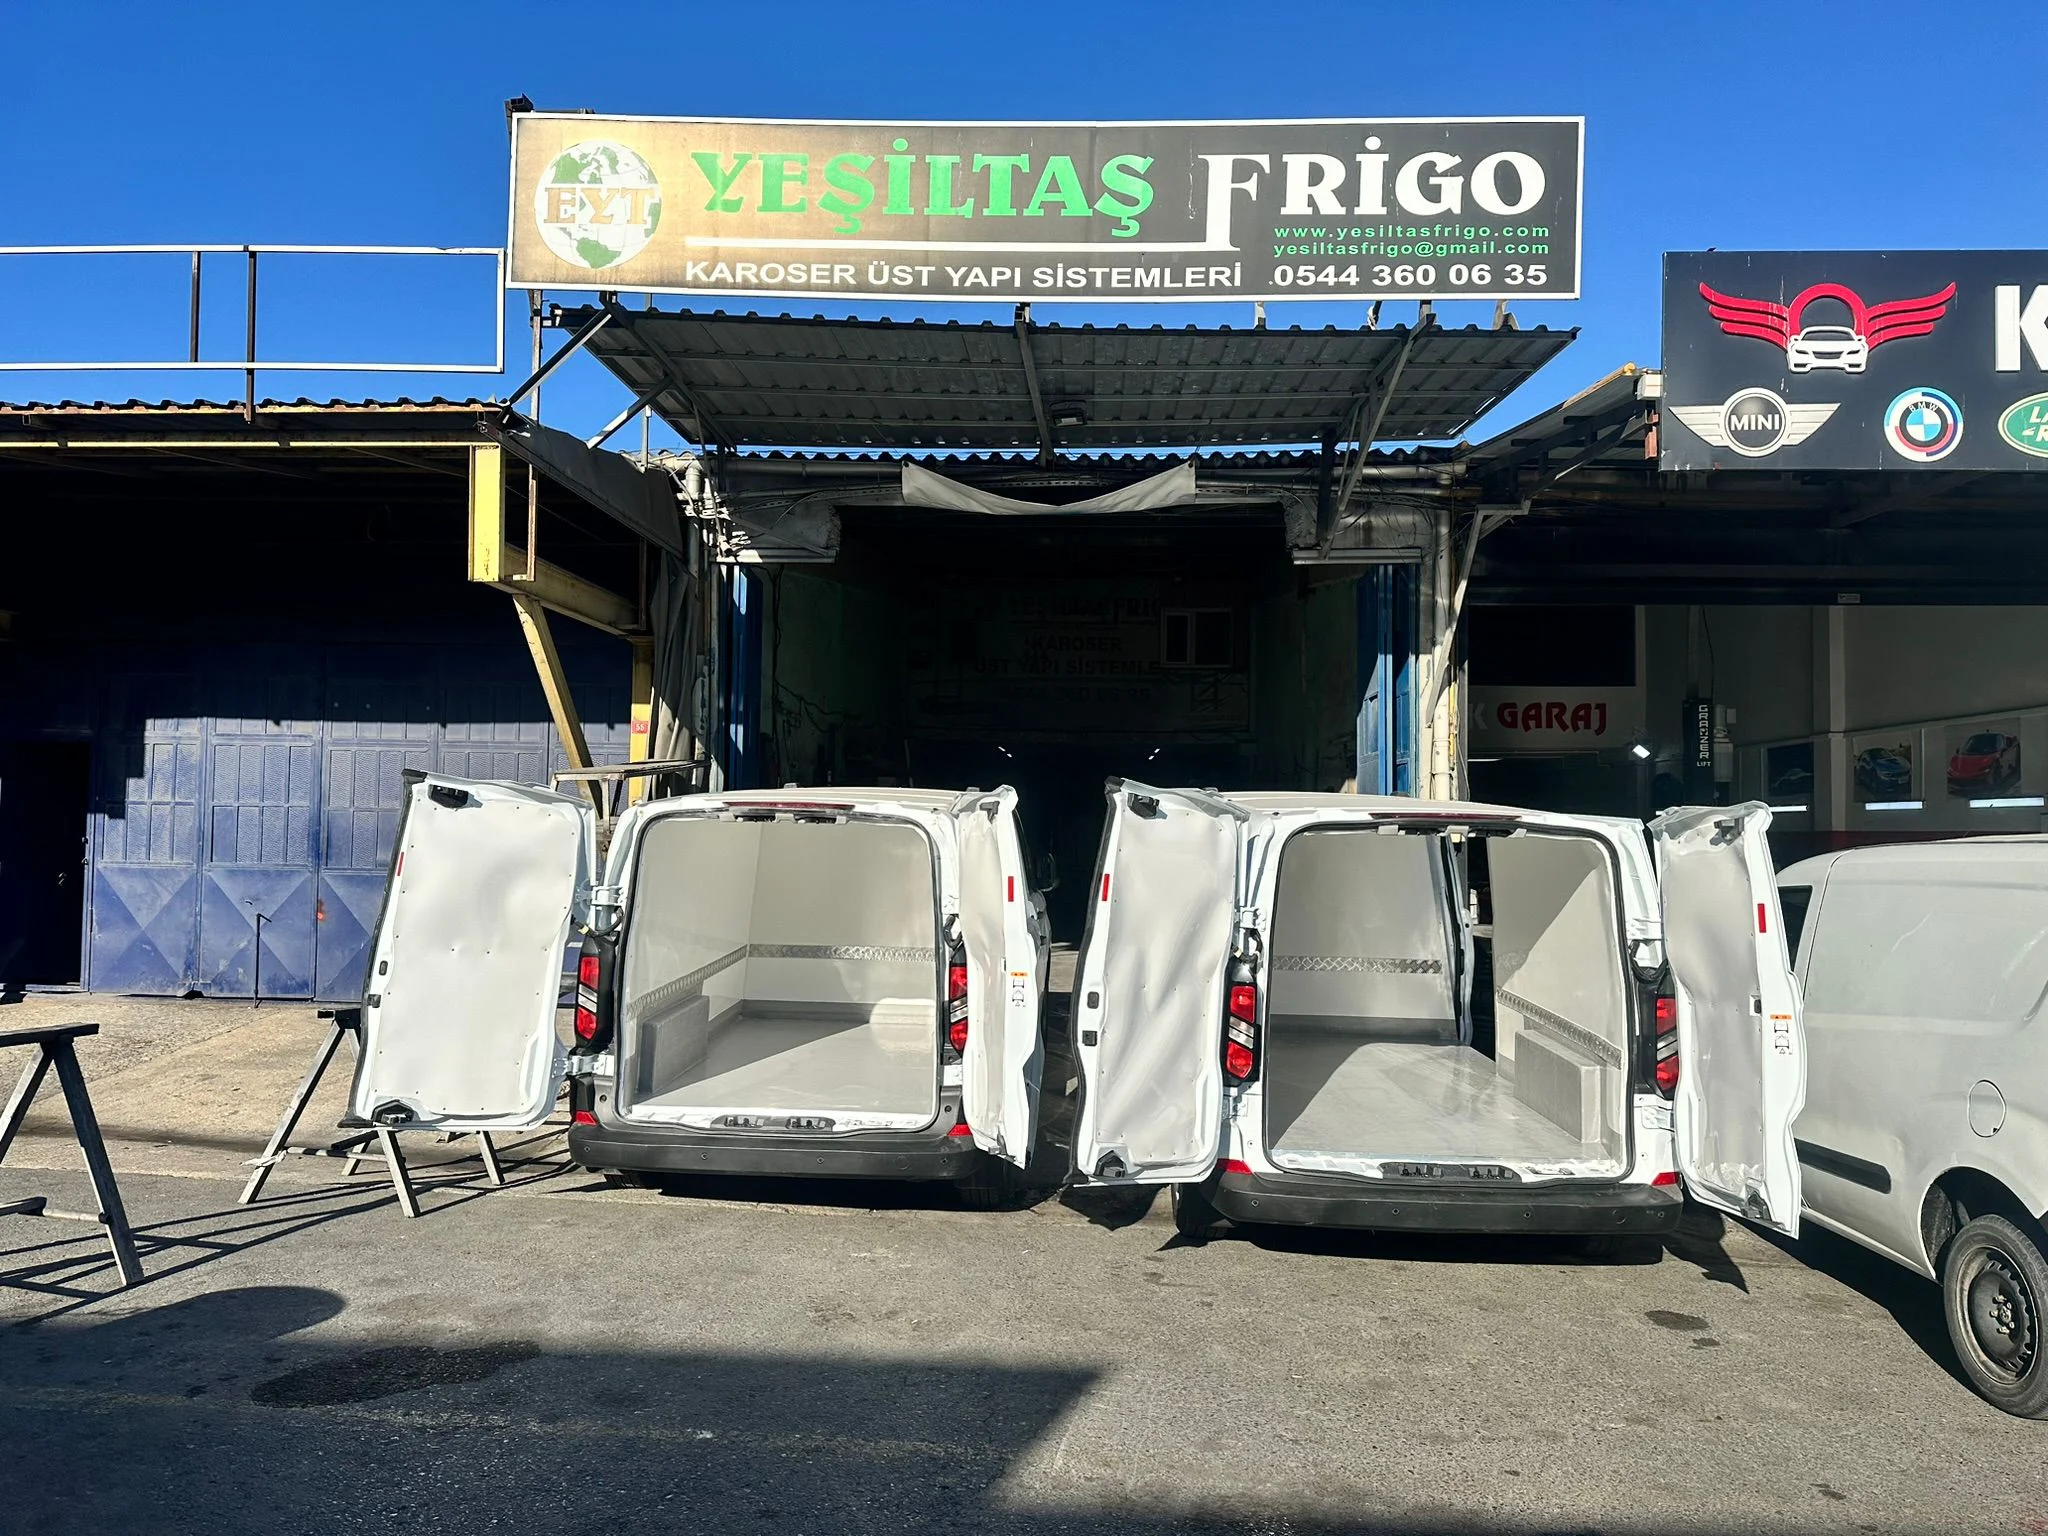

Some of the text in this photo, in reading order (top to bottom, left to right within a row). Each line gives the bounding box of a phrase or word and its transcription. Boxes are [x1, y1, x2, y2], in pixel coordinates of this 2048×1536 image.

[691, 135, 1546, 252] YEŞİLTAŞ FRİGO
[544, 187, 655, 225] EYT
[1274, 225, 1549, 241] www.yesiltasfrigo.com
[1273, 241, 1549, 258] yesiltasfrigo@gmail.com
[685, 261, 1241, 288] KAROSER ÜST YAPI SİSTEMLERİ
[1273, 264, 1548, 286] 0544 360 06 35
[1908, 400, 1939, 413] BMW
[1730, 414, 1781, 432] MINI
[1496, 702, 1607, 736] GARAJ
